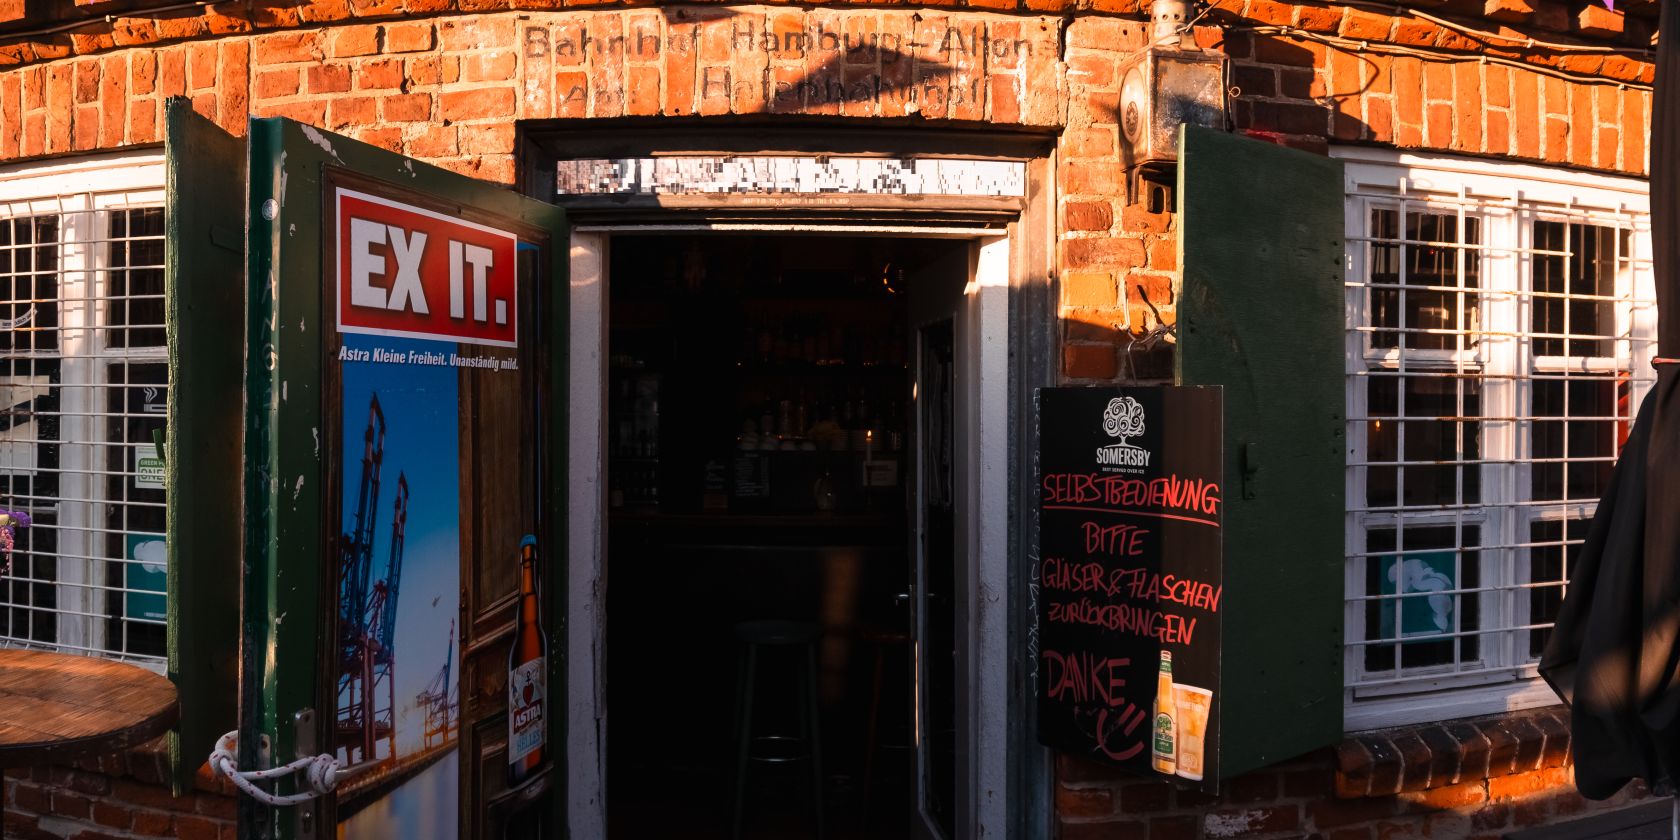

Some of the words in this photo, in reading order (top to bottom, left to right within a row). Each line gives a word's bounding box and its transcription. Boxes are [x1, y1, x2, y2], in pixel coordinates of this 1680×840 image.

[525, 23, 701, 58] Bahnhof
[350, 217, 430, 315] EX
[449, 240, 507, 325] IT.
[337, 345, 370, 362] Astra
[372, 347, 406, 365] Kleine
[408, 350, 448, 367] Freiheit.
[449, 354, 499, 372] Unanständig
[501, 357, 519, 370] mild.
[1096, 447, 1151, 466] SOMERSBY
[1043, 472, 1222, 515] SELBSTBEDIENUNG
[1081, 521, 1150, 556] BITTE
[1041, 557, 1109, 593] GLÄSER
[1107, 568, 1126, 597] &
[1124, 567, 1222, 612] FLASCHEN
[1047, 597, 1197, 646] ZURÜCKBRINGEN
[1042, 648, 1131, 707] DANKE
[515, 704, 542, 728] ASTRA
